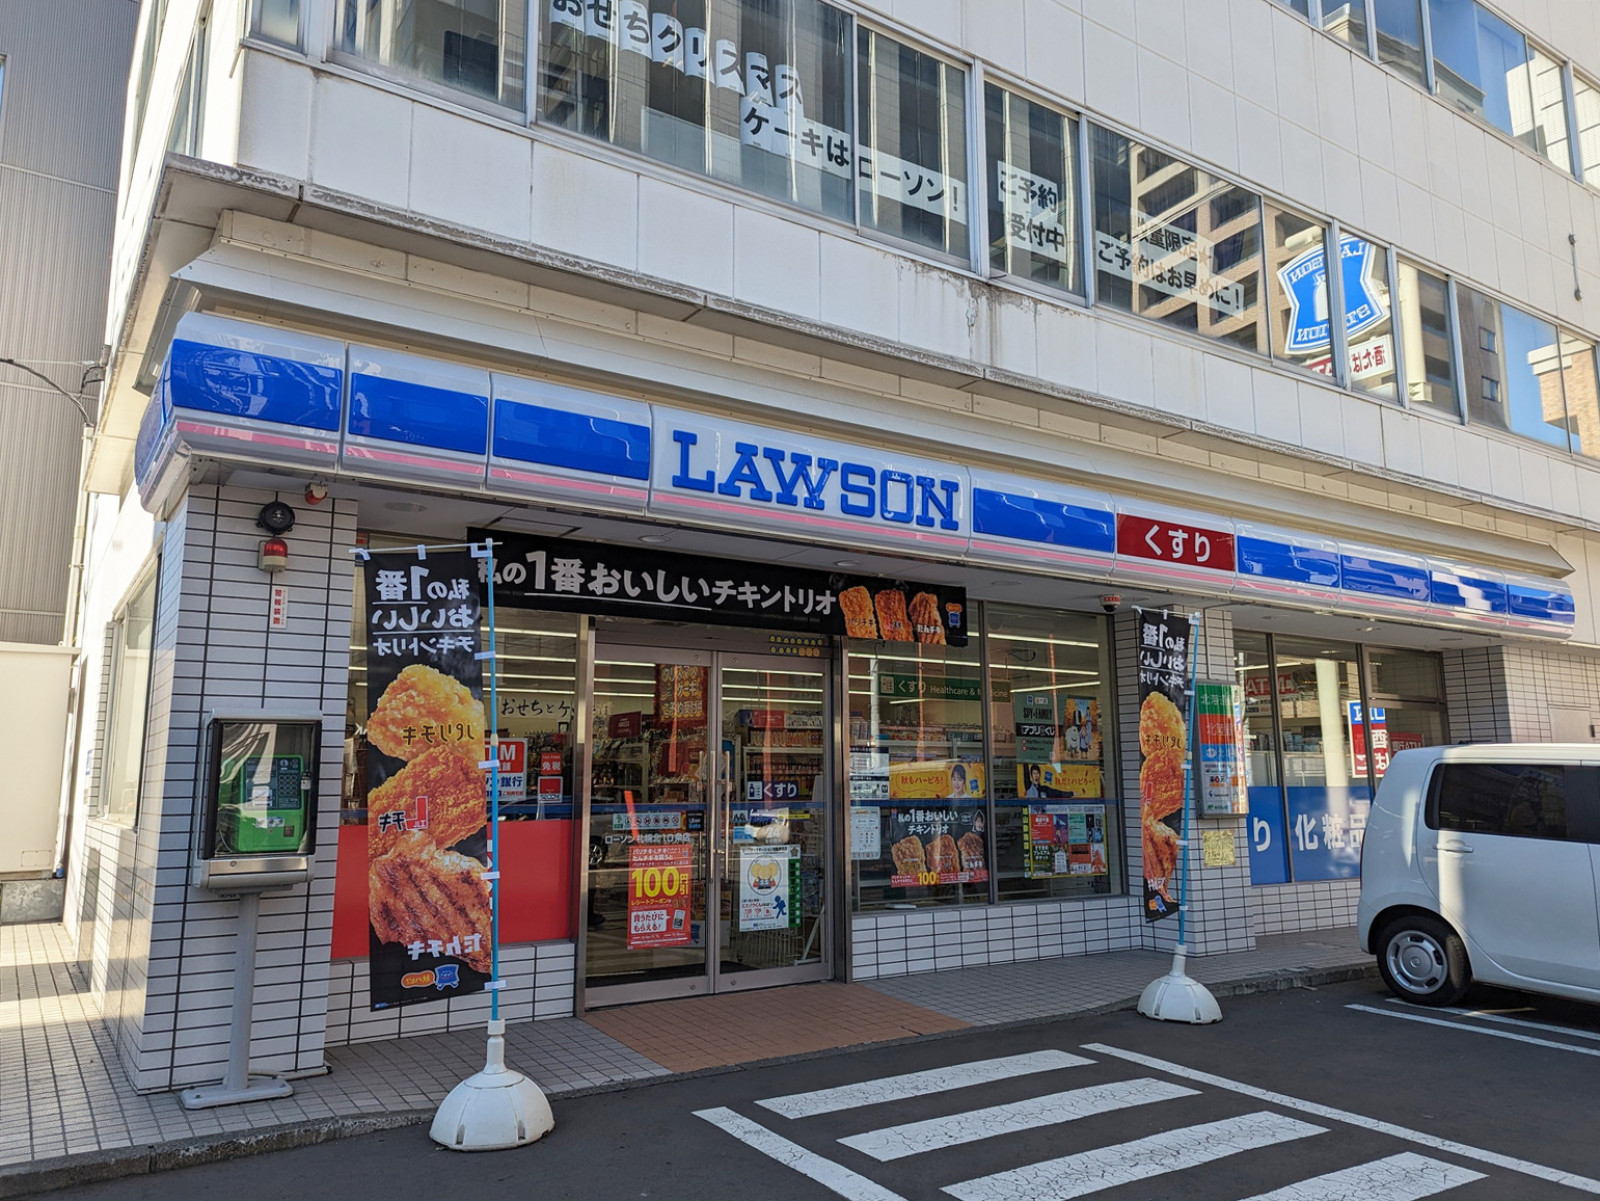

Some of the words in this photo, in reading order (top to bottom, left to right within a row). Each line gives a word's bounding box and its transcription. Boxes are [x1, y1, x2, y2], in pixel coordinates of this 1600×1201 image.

[1000, 170, 1058, 213] ご予約
[1008, 211, 1065, 252] 受付中
[672, 429, 960, 531] LAWSON
[1143, 524, 1212, 563] くすり
[899, 680, 926, 693] くすり
[930, 685, 968, 696] Healthcare
[501, 698, 574, 717] おせちとケ
[764, 782, 798, 798] くすり
[631, 866, 680, 898] 100
[918, 871, 937, 885] 100
